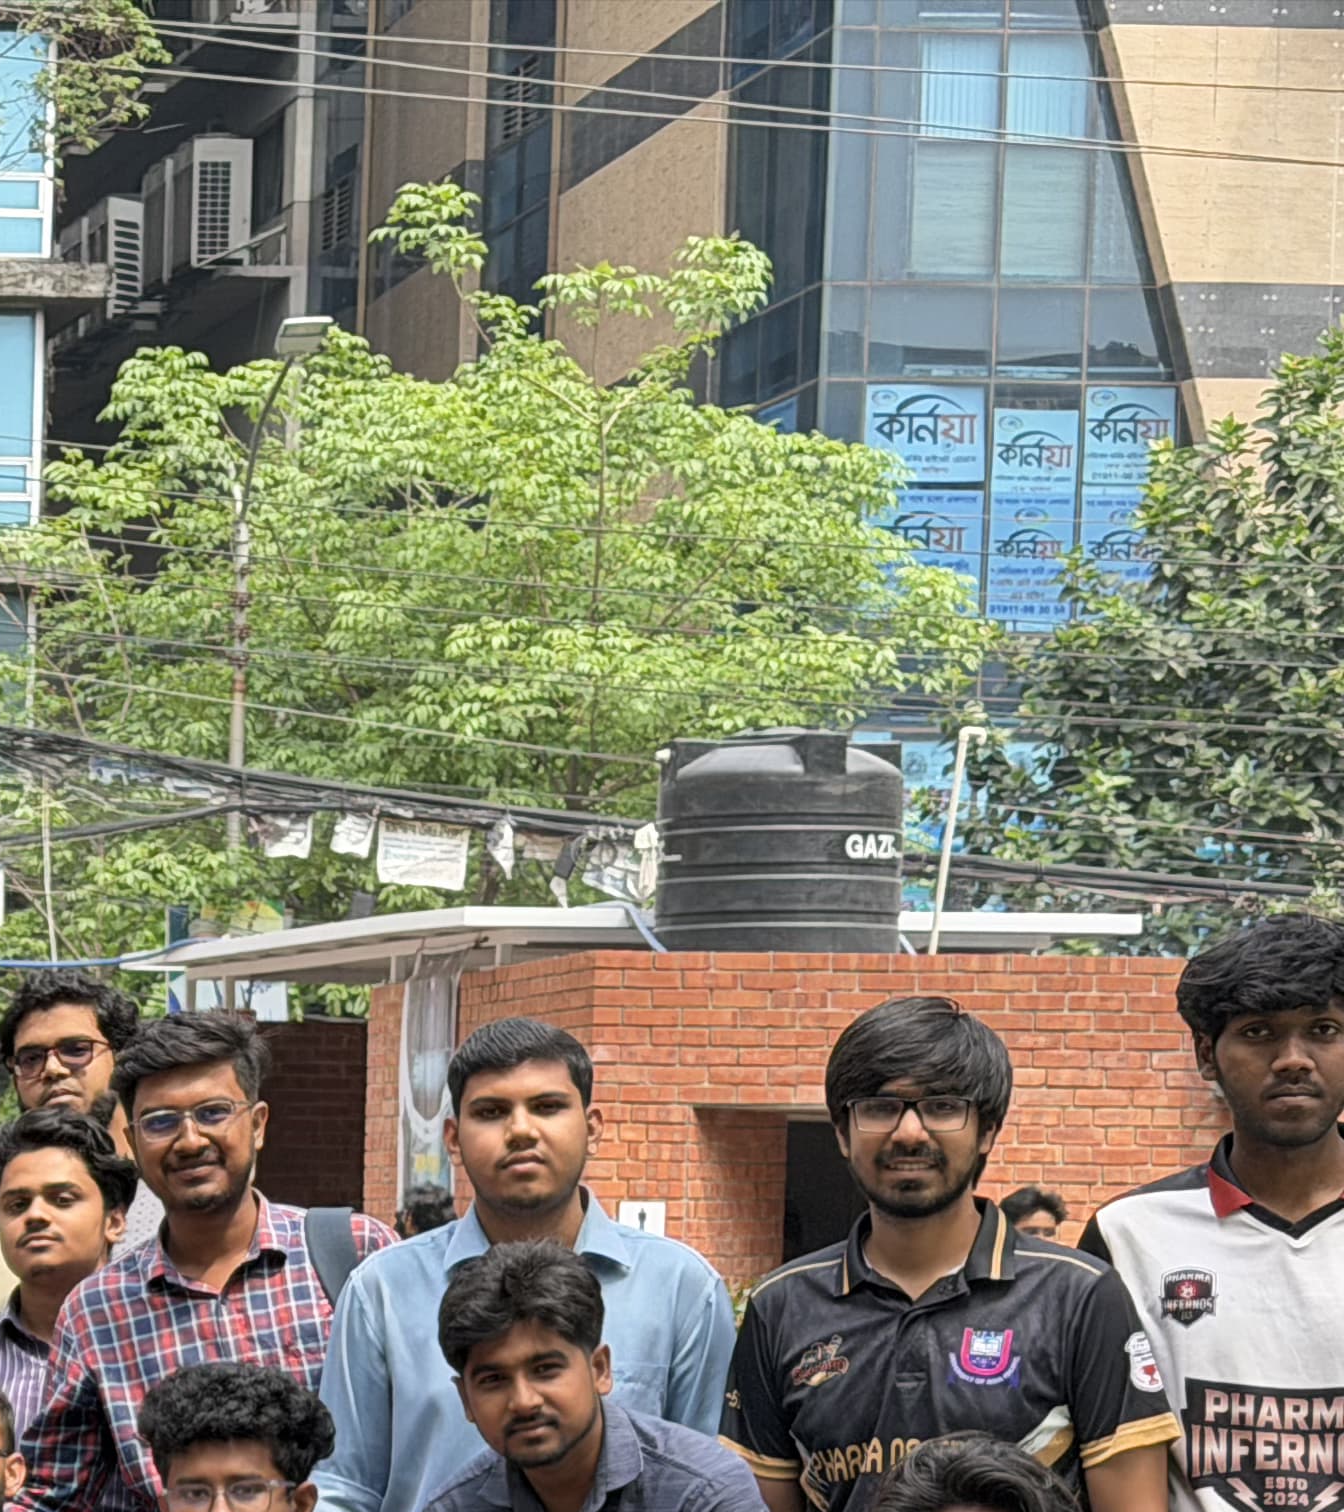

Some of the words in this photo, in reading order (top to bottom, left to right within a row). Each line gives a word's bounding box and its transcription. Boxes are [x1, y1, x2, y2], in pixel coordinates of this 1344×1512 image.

[1204, 1388, 1344, 1430] PHARM
[1191, 1424, 1344, 1477] INFERN
[1265, 1476, 1308, 1491] ESTD
[1263, 1492, 1309, 1506] 2024
